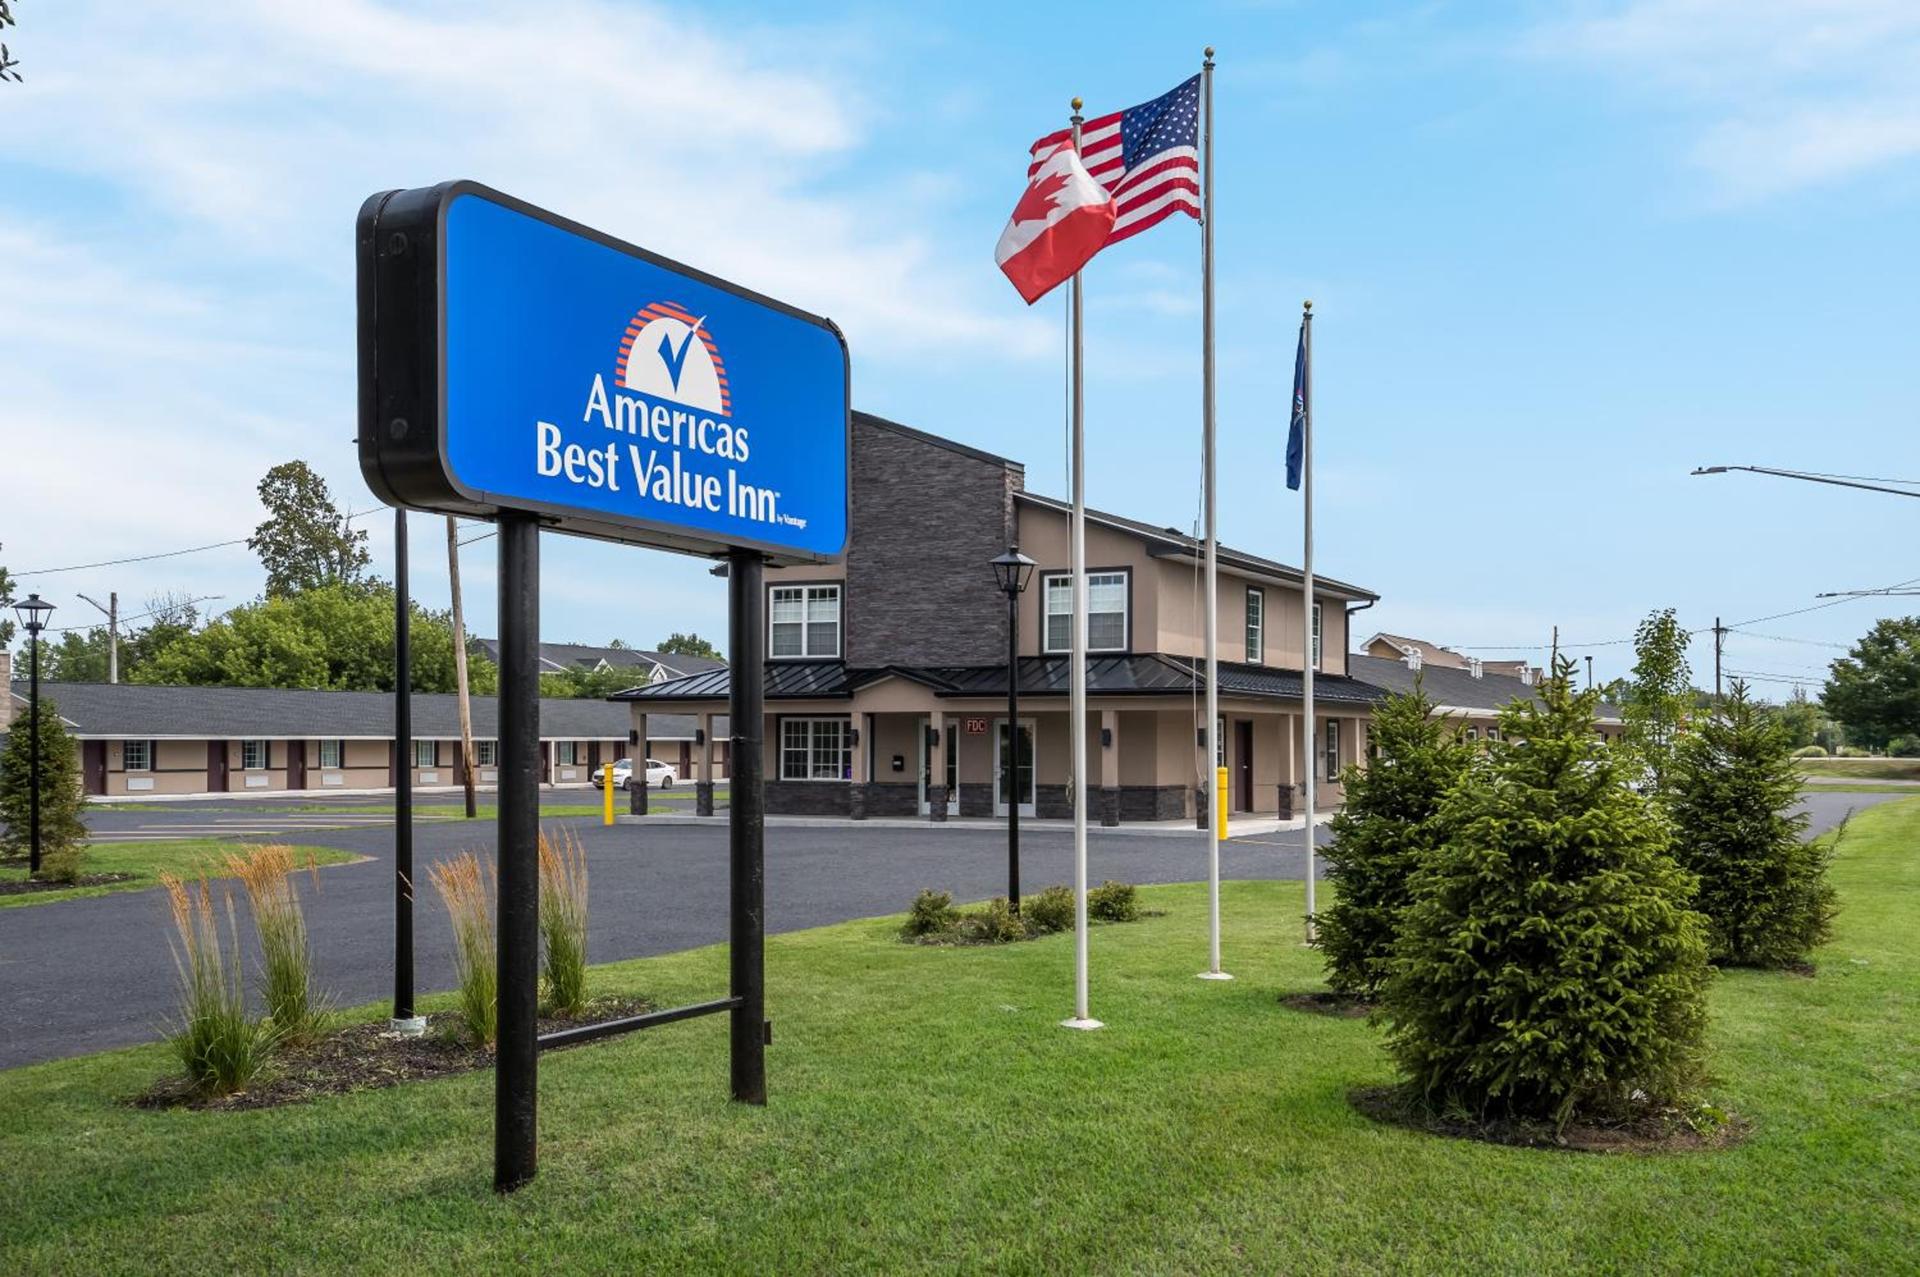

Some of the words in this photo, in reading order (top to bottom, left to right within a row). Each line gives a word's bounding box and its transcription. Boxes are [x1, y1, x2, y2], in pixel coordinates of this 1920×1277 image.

[583, 373, 749, 463] Americas
[537, 421, 620, 491] Best
[629, 445, 722, 512] Value
[728, 469, 776, 523] Inn
[967, 720, 985, 731] FDC
